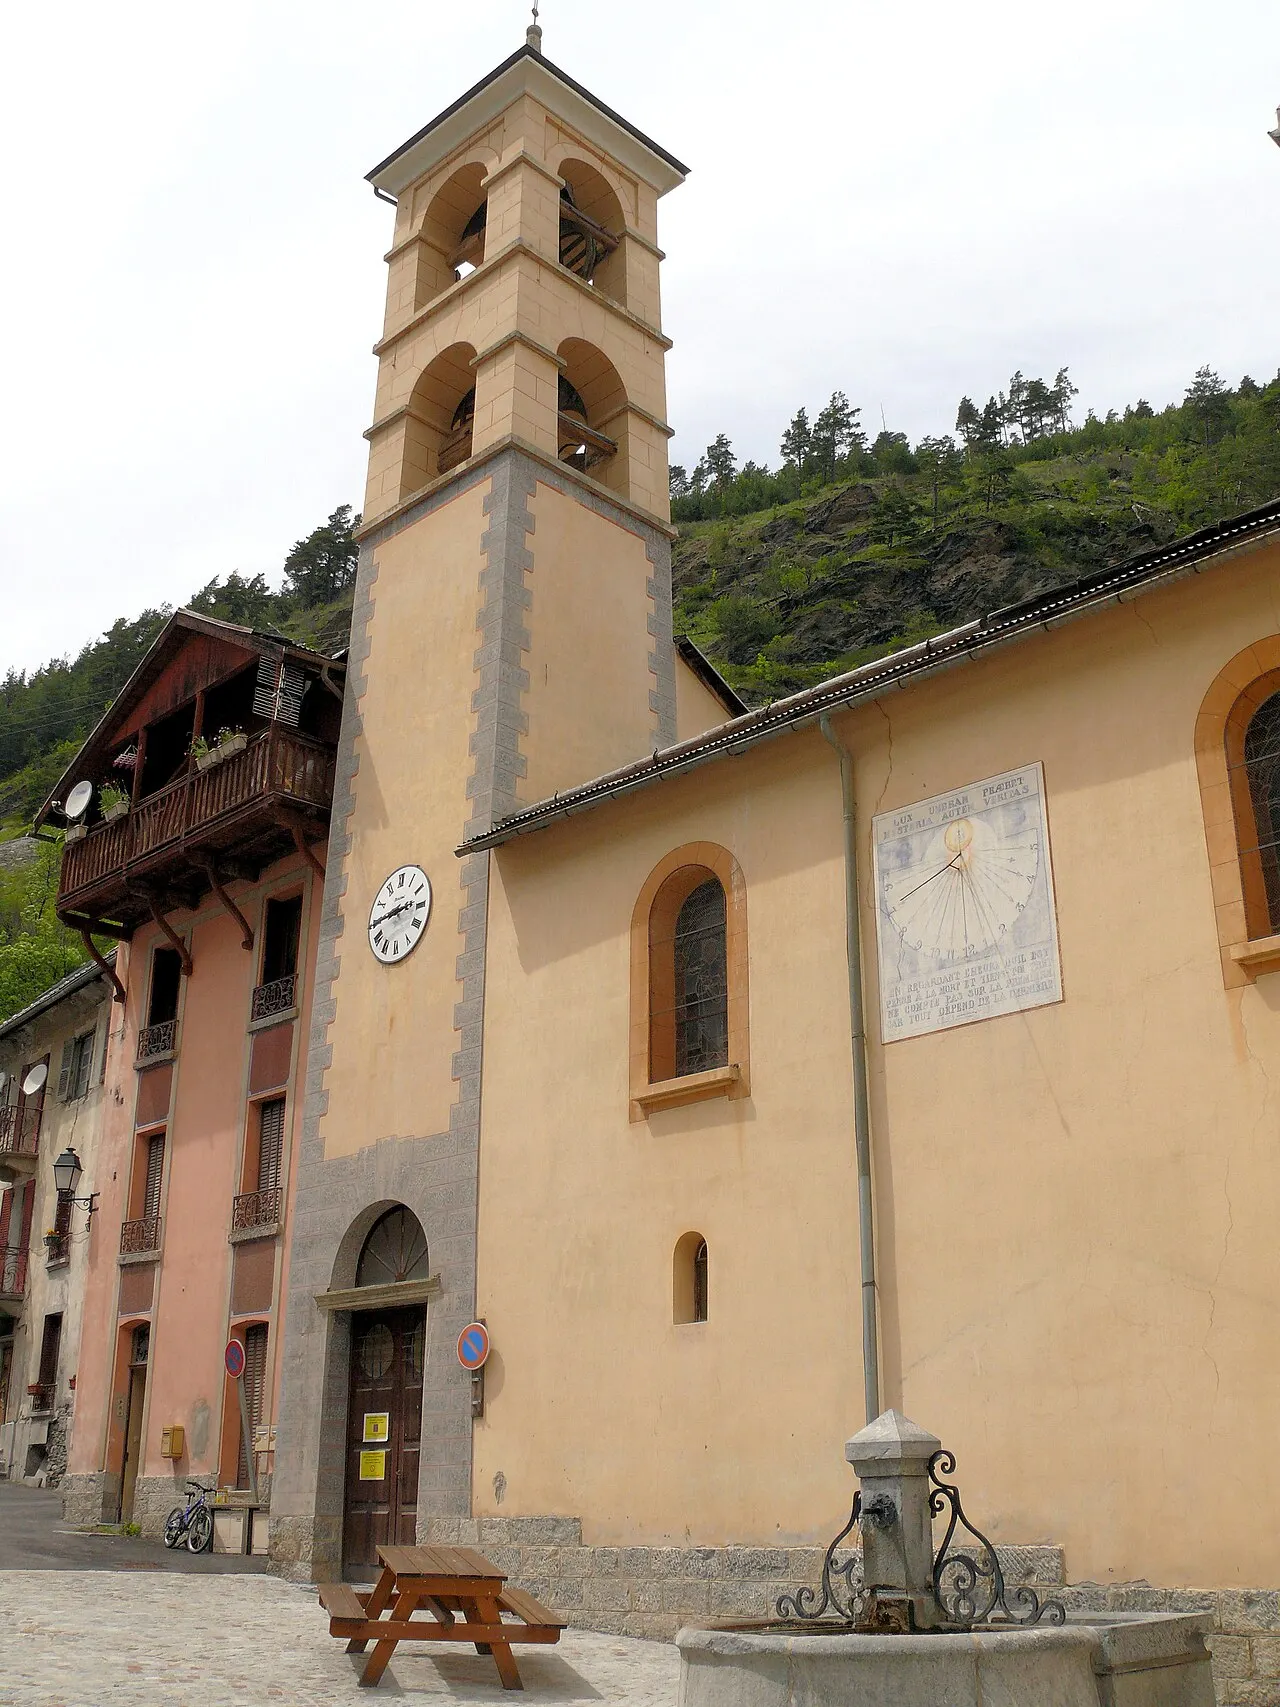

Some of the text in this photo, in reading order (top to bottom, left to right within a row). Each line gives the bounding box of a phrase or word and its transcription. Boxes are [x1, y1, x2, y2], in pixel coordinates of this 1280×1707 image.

[983, 783, 1029, 806] VERITAS
[893, 813, 912, 826] LUX
[1026, 874, 1035, 884] 4
[1015, 902, 1025, 912] 3
[899, 927, 907, 939] 8
[938, 980, 960, 995] MORT
[904, 997, 939, 1014] COMPTE
[945, 991, 962, 1004] PAS
[967, 985, 986, 998] SUR
[988, 980, 1002, 992] LA
[909, 1009, 931, 1024] TOUT
[977, 995, 990, 1006] DE
[992, 991, 1006, 1003] LA
